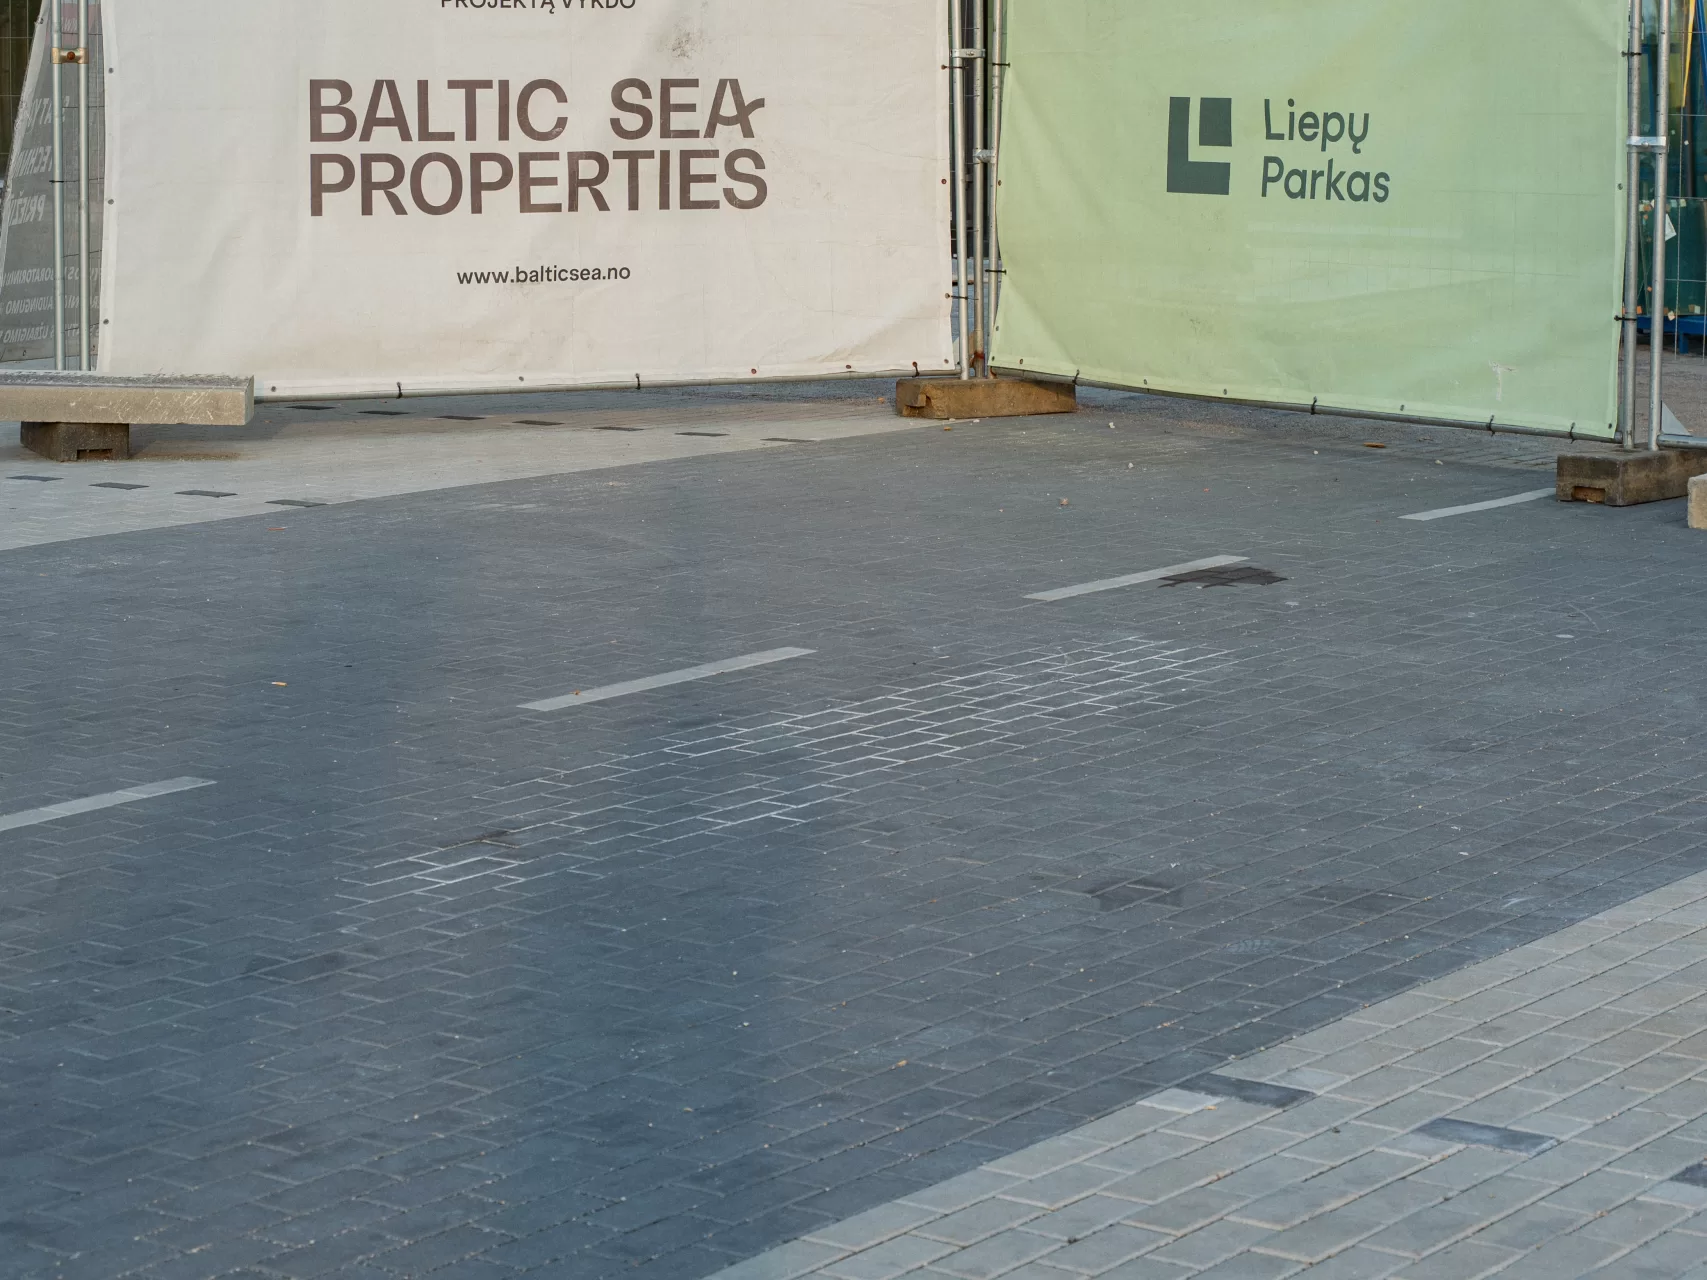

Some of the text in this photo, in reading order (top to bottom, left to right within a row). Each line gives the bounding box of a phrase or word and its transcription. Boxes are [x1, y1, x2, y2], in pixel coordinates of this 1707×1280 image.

[310, 78, 765, 142] BALTIC SEA
[1264, 97, 1369, 154] Liepų
[310, 149, 767, 216] PROPERTIES
[1261, 155, 1390, 203] Parkas
[457, 265, 630, 284] www.balticsea.no
